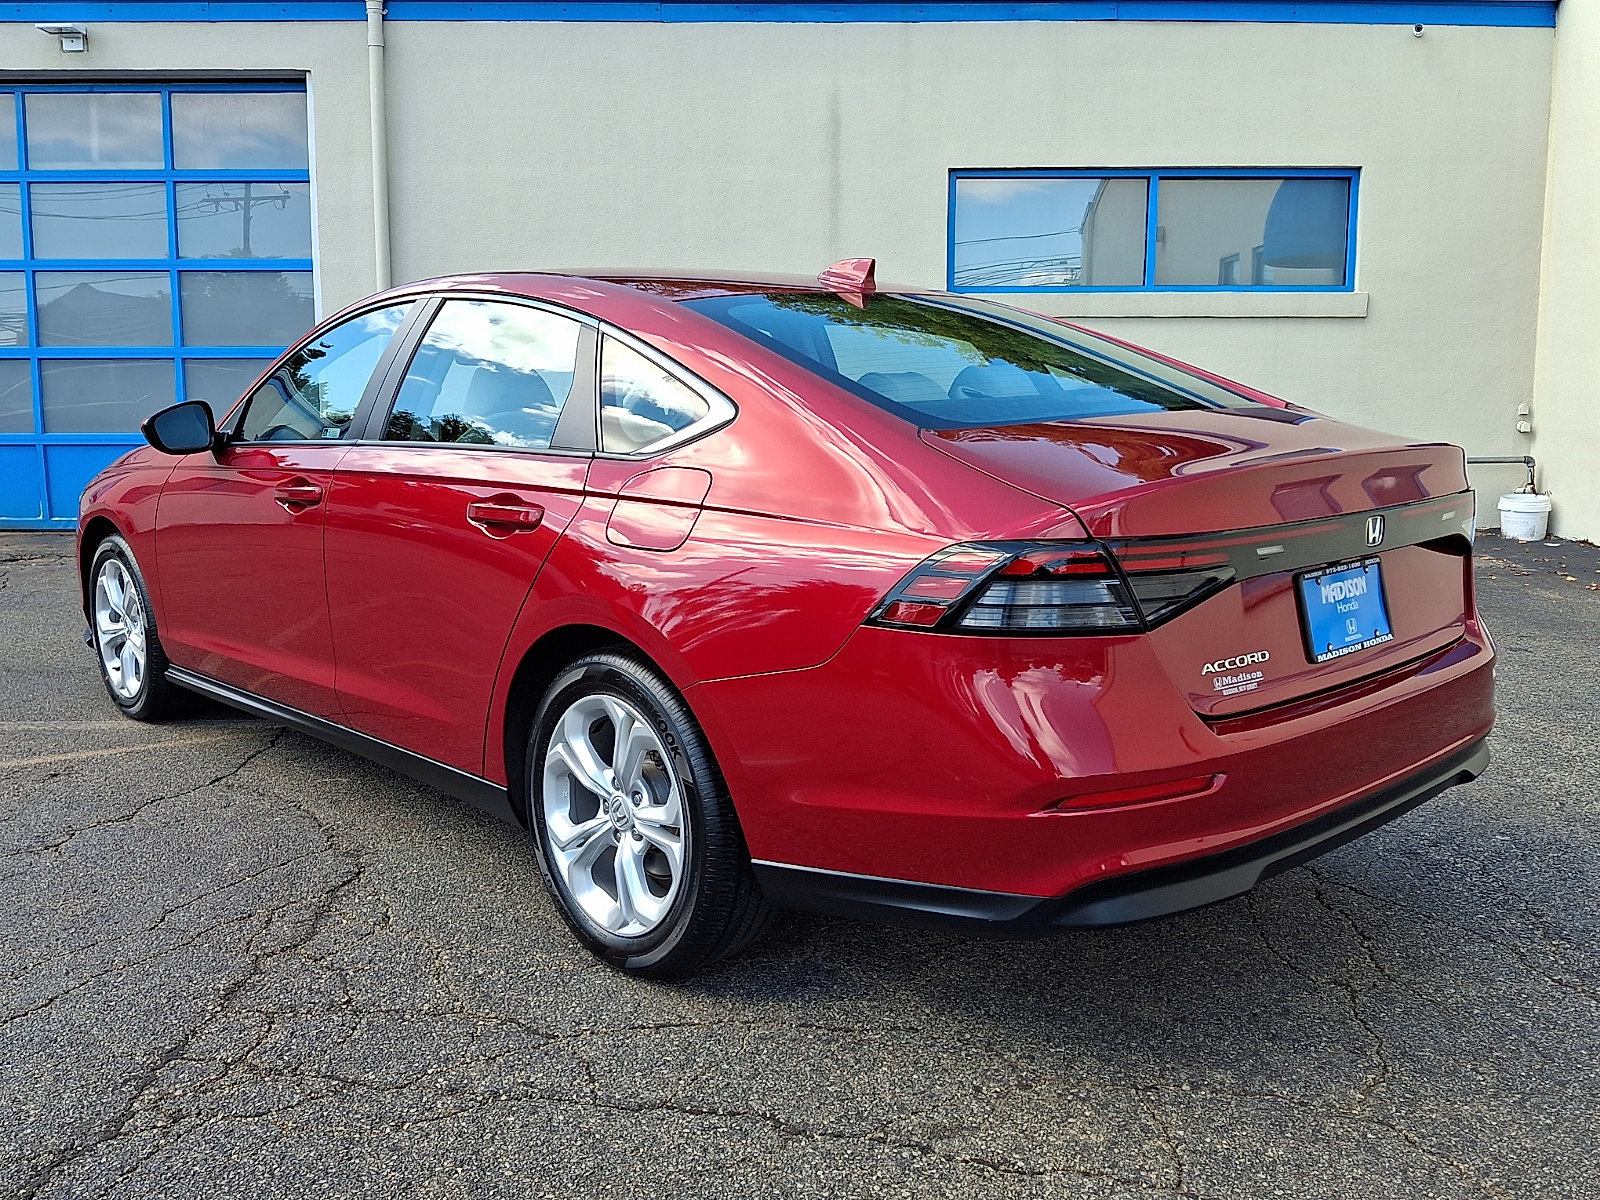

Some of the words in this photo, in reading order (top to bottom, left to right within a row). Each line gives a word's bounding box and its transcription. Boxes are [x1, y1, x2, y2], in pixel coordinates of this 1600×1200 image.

[1321, 576, 1367, 604] MADISON
[1337, 599, 1359, 614] Honda
[1317, 643, 1362, 662] MADISON
[1363, 633, 1394, 649] HONDA
[1201, 650, 1270, 675] ACCORD
[1222, 671, 1263, 686] Madison
